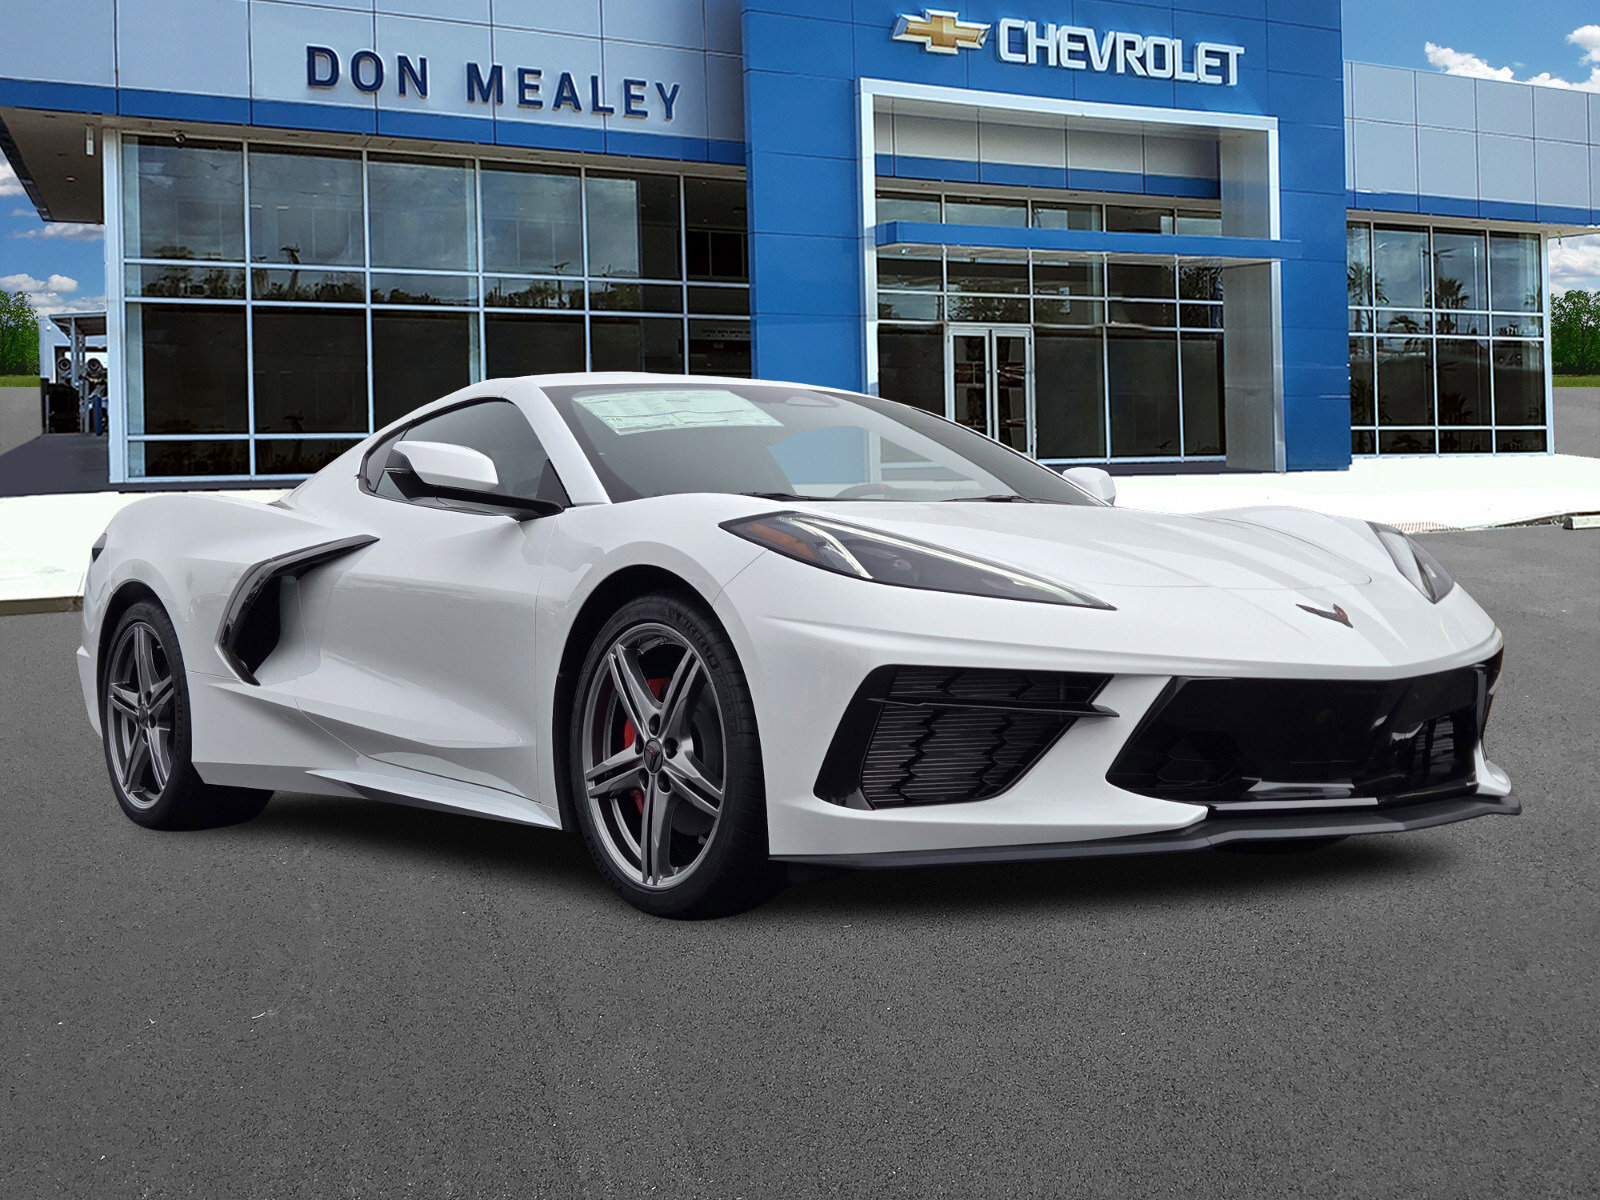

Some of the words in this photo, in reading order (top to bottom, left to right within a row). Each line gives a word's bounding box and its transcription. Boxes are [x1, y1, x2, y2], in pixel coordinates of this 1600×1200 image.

[306, 45, 428, 98] DON
[466, 62, 680, 121] MEALEY
[998, 18, 1244, 86] CHEVROLET
